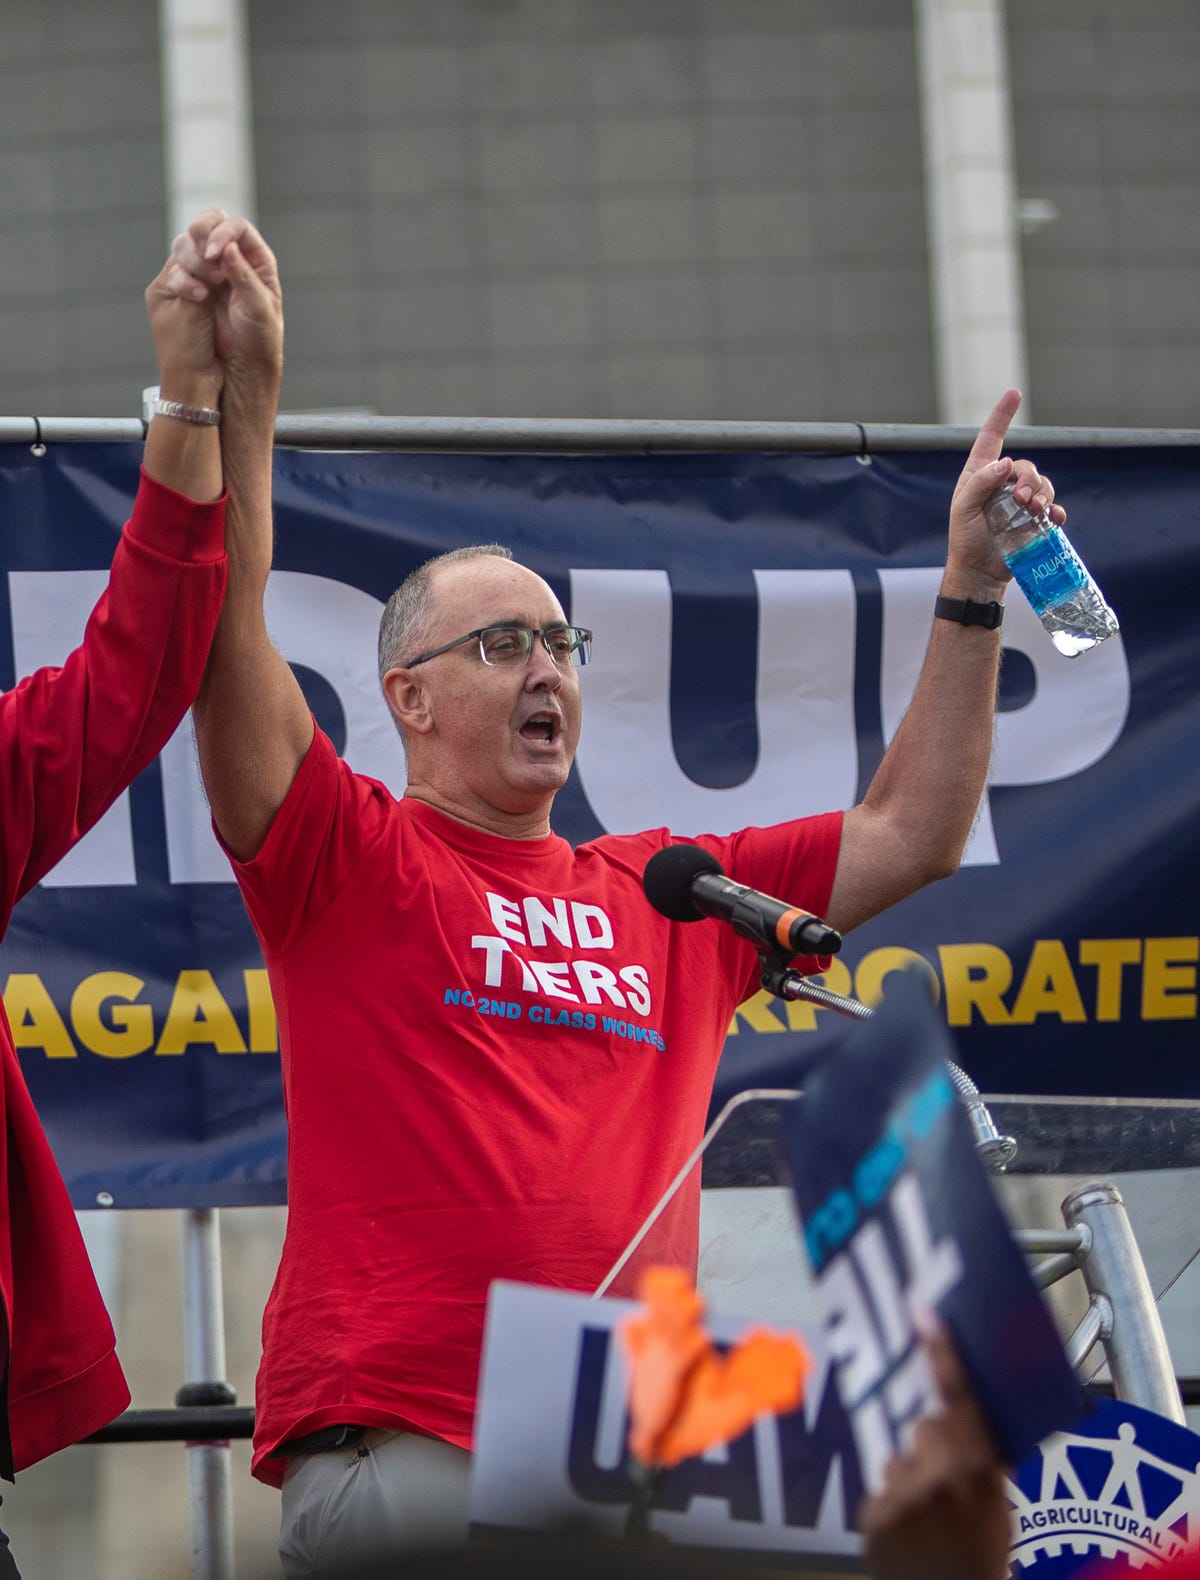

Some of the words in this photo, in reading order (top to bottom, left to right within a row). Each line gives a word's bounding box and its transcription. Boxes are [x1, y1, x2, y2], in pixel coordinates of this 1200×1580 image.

[568, 566, 1132, 868] UP
[485, 891, 614, 950] END
[471, 935, 651, 1017] TIERS
[1, 969, 279, 1060] AGAI
[477, 998, 522, 1019] 2ND
[529, 1006, 597, 1031] CLASS
[1019, 1506, 1163, 1550] AGRICULTURAL
